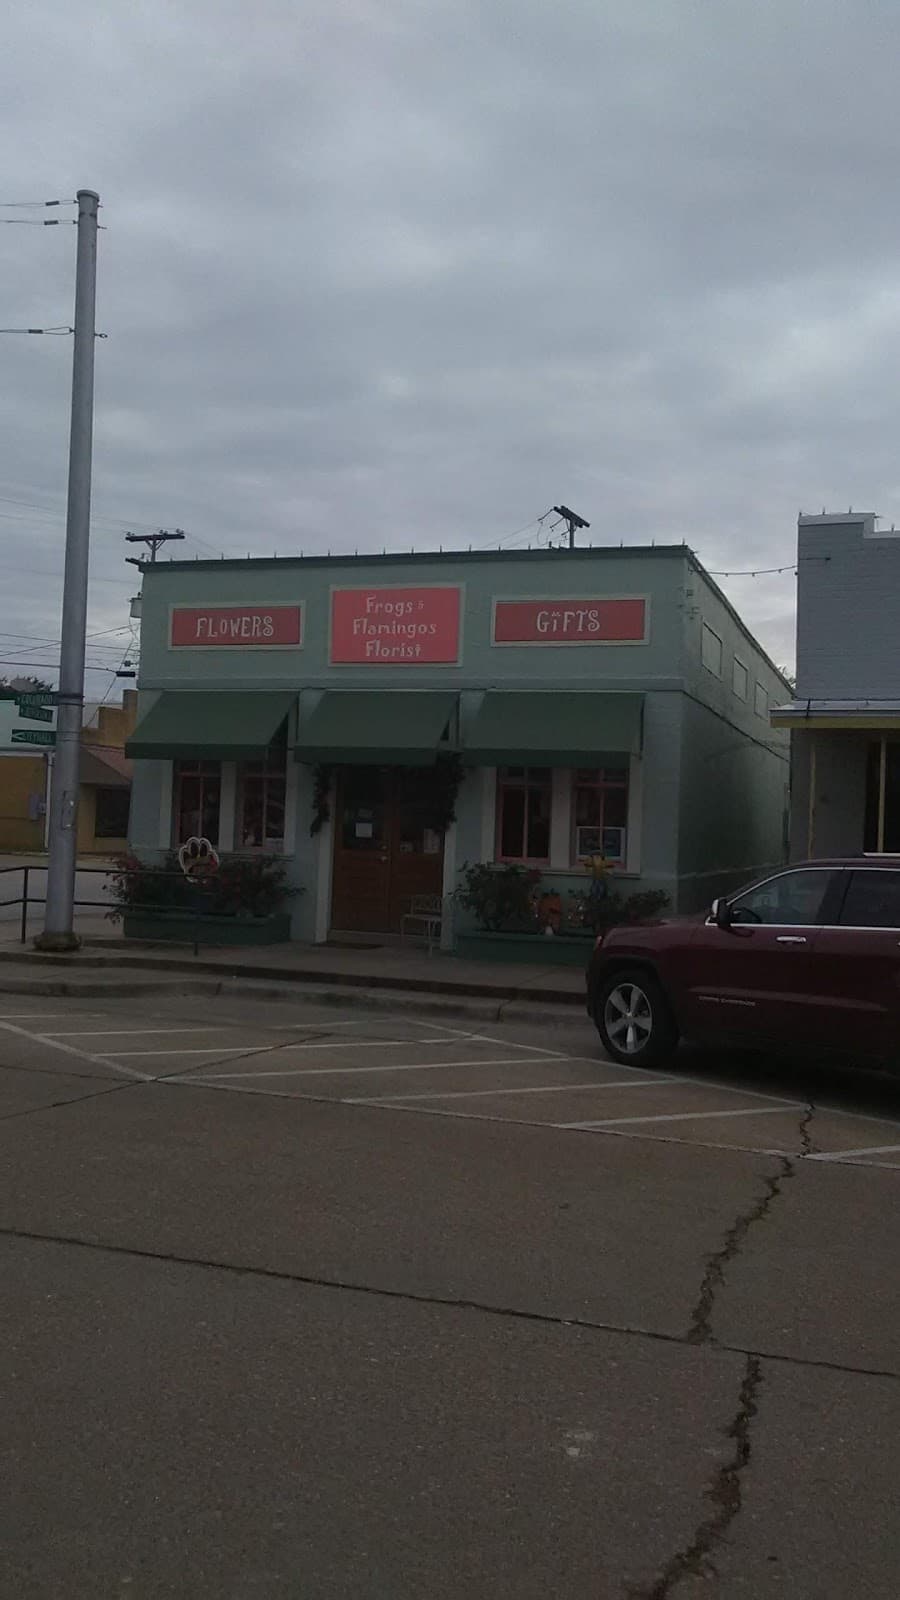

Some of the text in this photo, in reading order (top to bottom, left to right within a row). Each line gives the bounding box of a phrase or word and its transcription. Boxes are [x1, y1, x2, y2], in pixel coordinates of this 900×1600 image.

[366, 595, 413, 617] Frogs
[195, 615, 274, 638] FLOWERS
[352, 617, 437, 638] Flamingos
[365, 639, 421, 657] Florist
